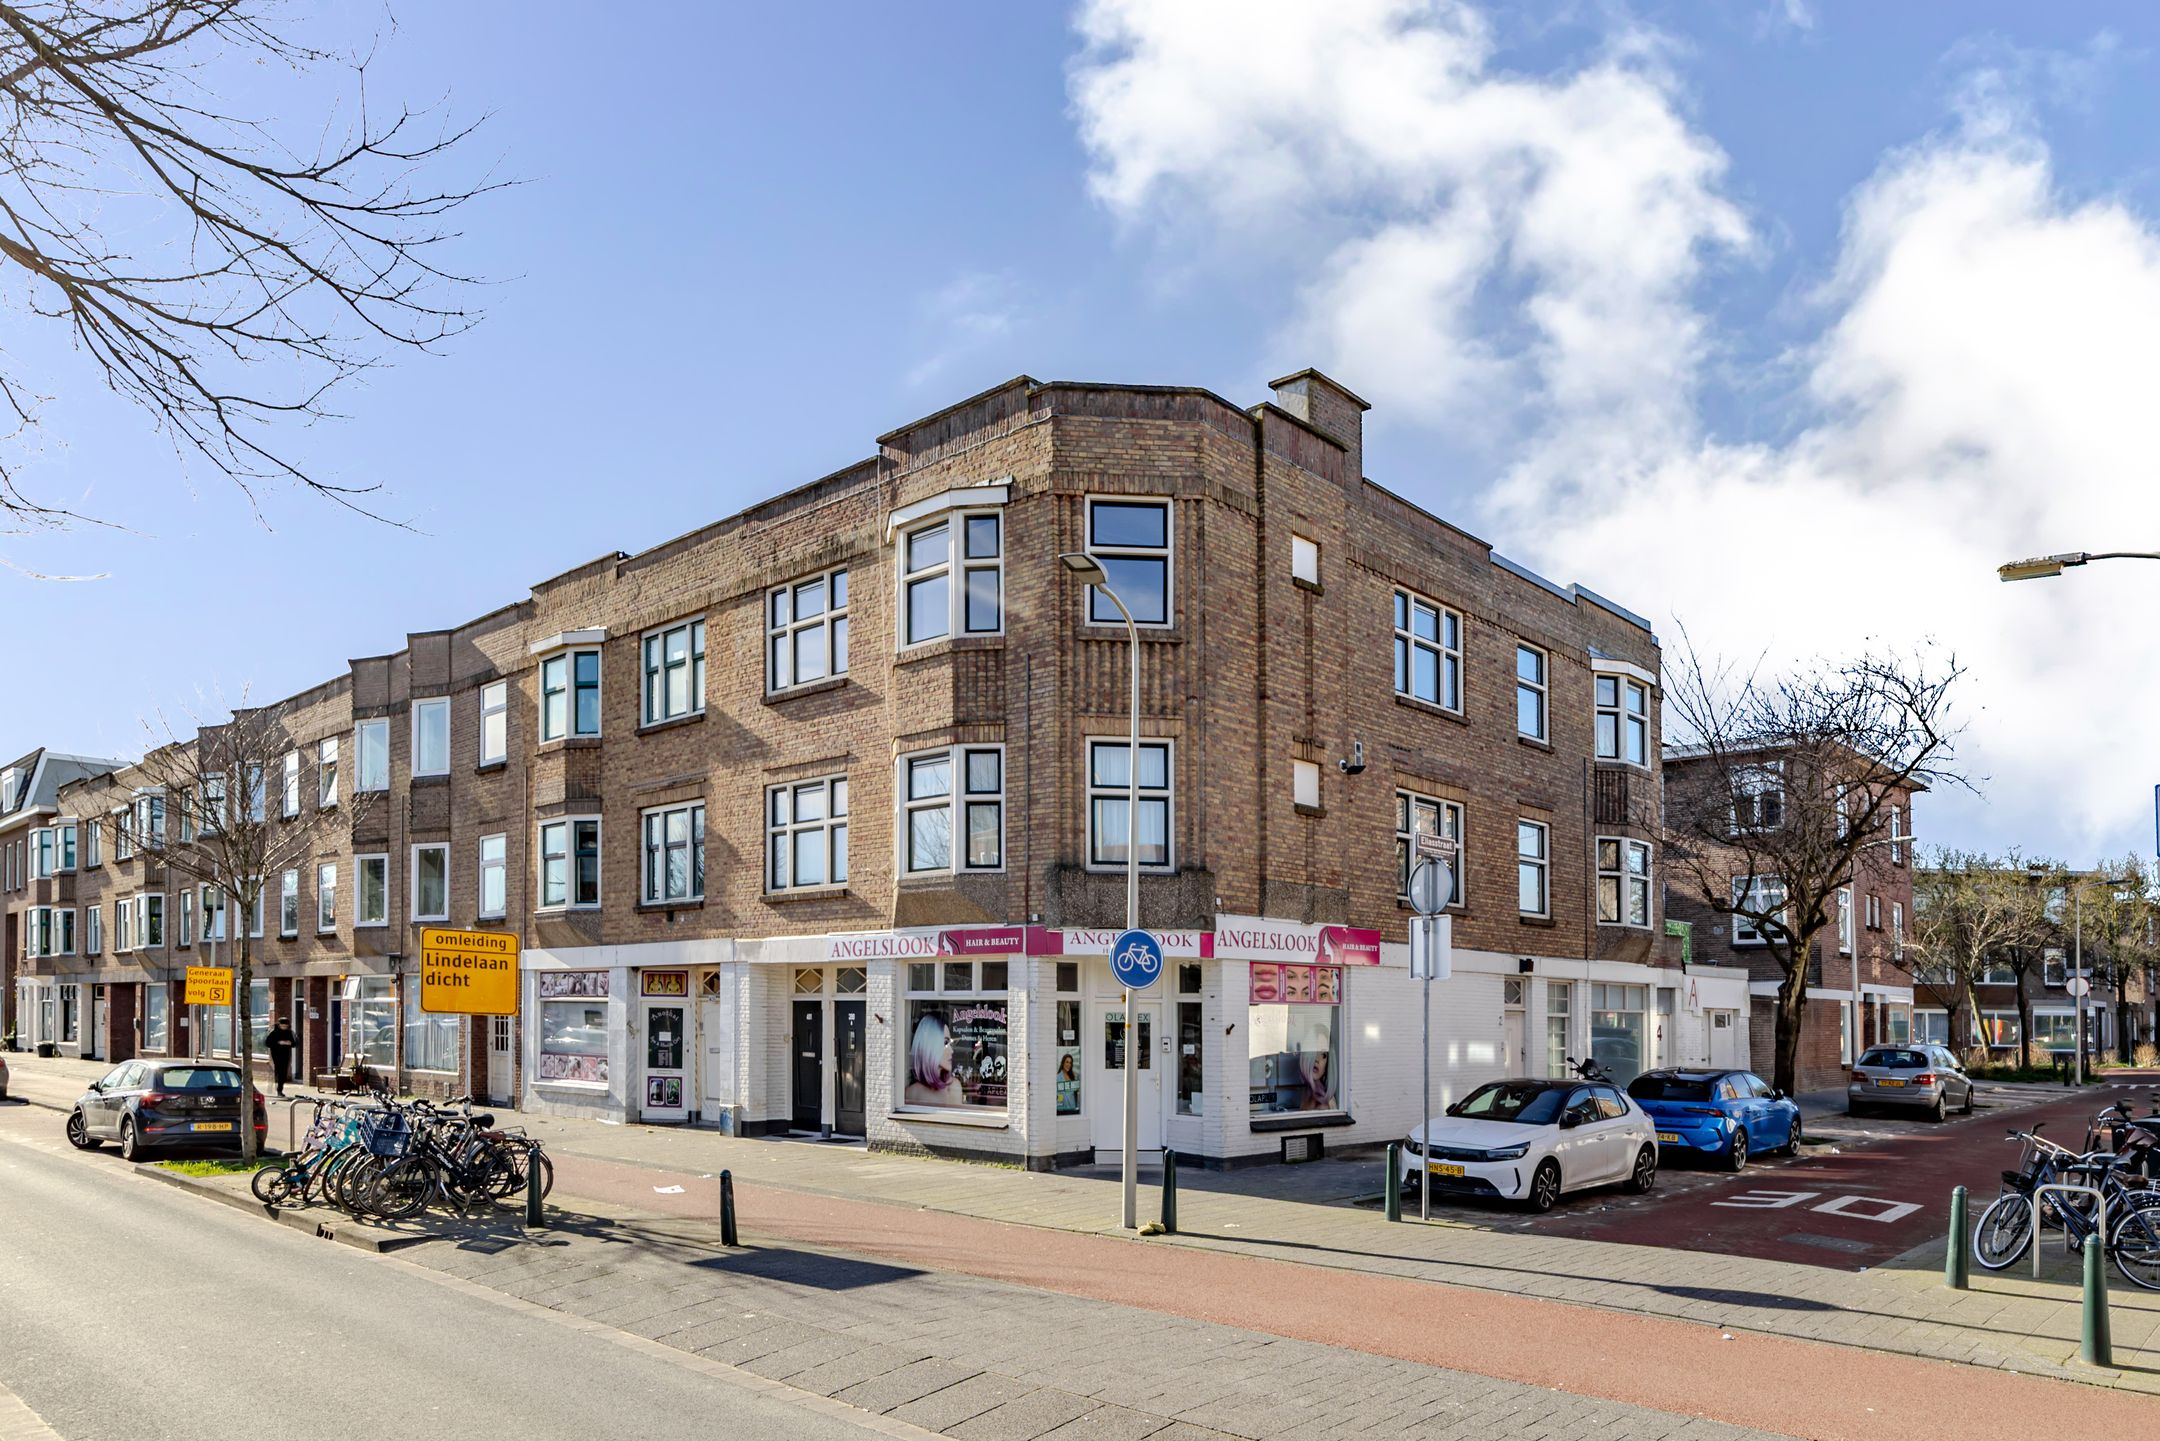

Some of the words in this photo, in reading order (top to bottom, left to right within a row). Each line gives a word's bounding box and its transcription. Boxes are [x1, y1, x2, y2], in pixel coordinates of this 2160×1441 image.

[435, 934, 507, 951] omleiding
[831, 936, 934, 958] ANGELSLOOK
[965, 939, 984, 947] HAIR
[984, 938, 990, 946] &
[991, 937, 1020, 946] BEAUTY
[1070, 931, 1193, 947] ANGEOOK
[1217, 930, 1316, 952] ANGELSLOOK
[426, 952, 508, 970] Lindelaan
[188, 969, 225, 977] Generaal
[188, 977, 229, 985] Spoorlaan
[425, 971, 470, 987] dicht
[213, 989, 220, 999] S
[952, 1003, 1007, 1025] Angelslook
[1105, 1013, 1149, 1021] OLAEX
[1656, 1025, 1662, 1041] 4
